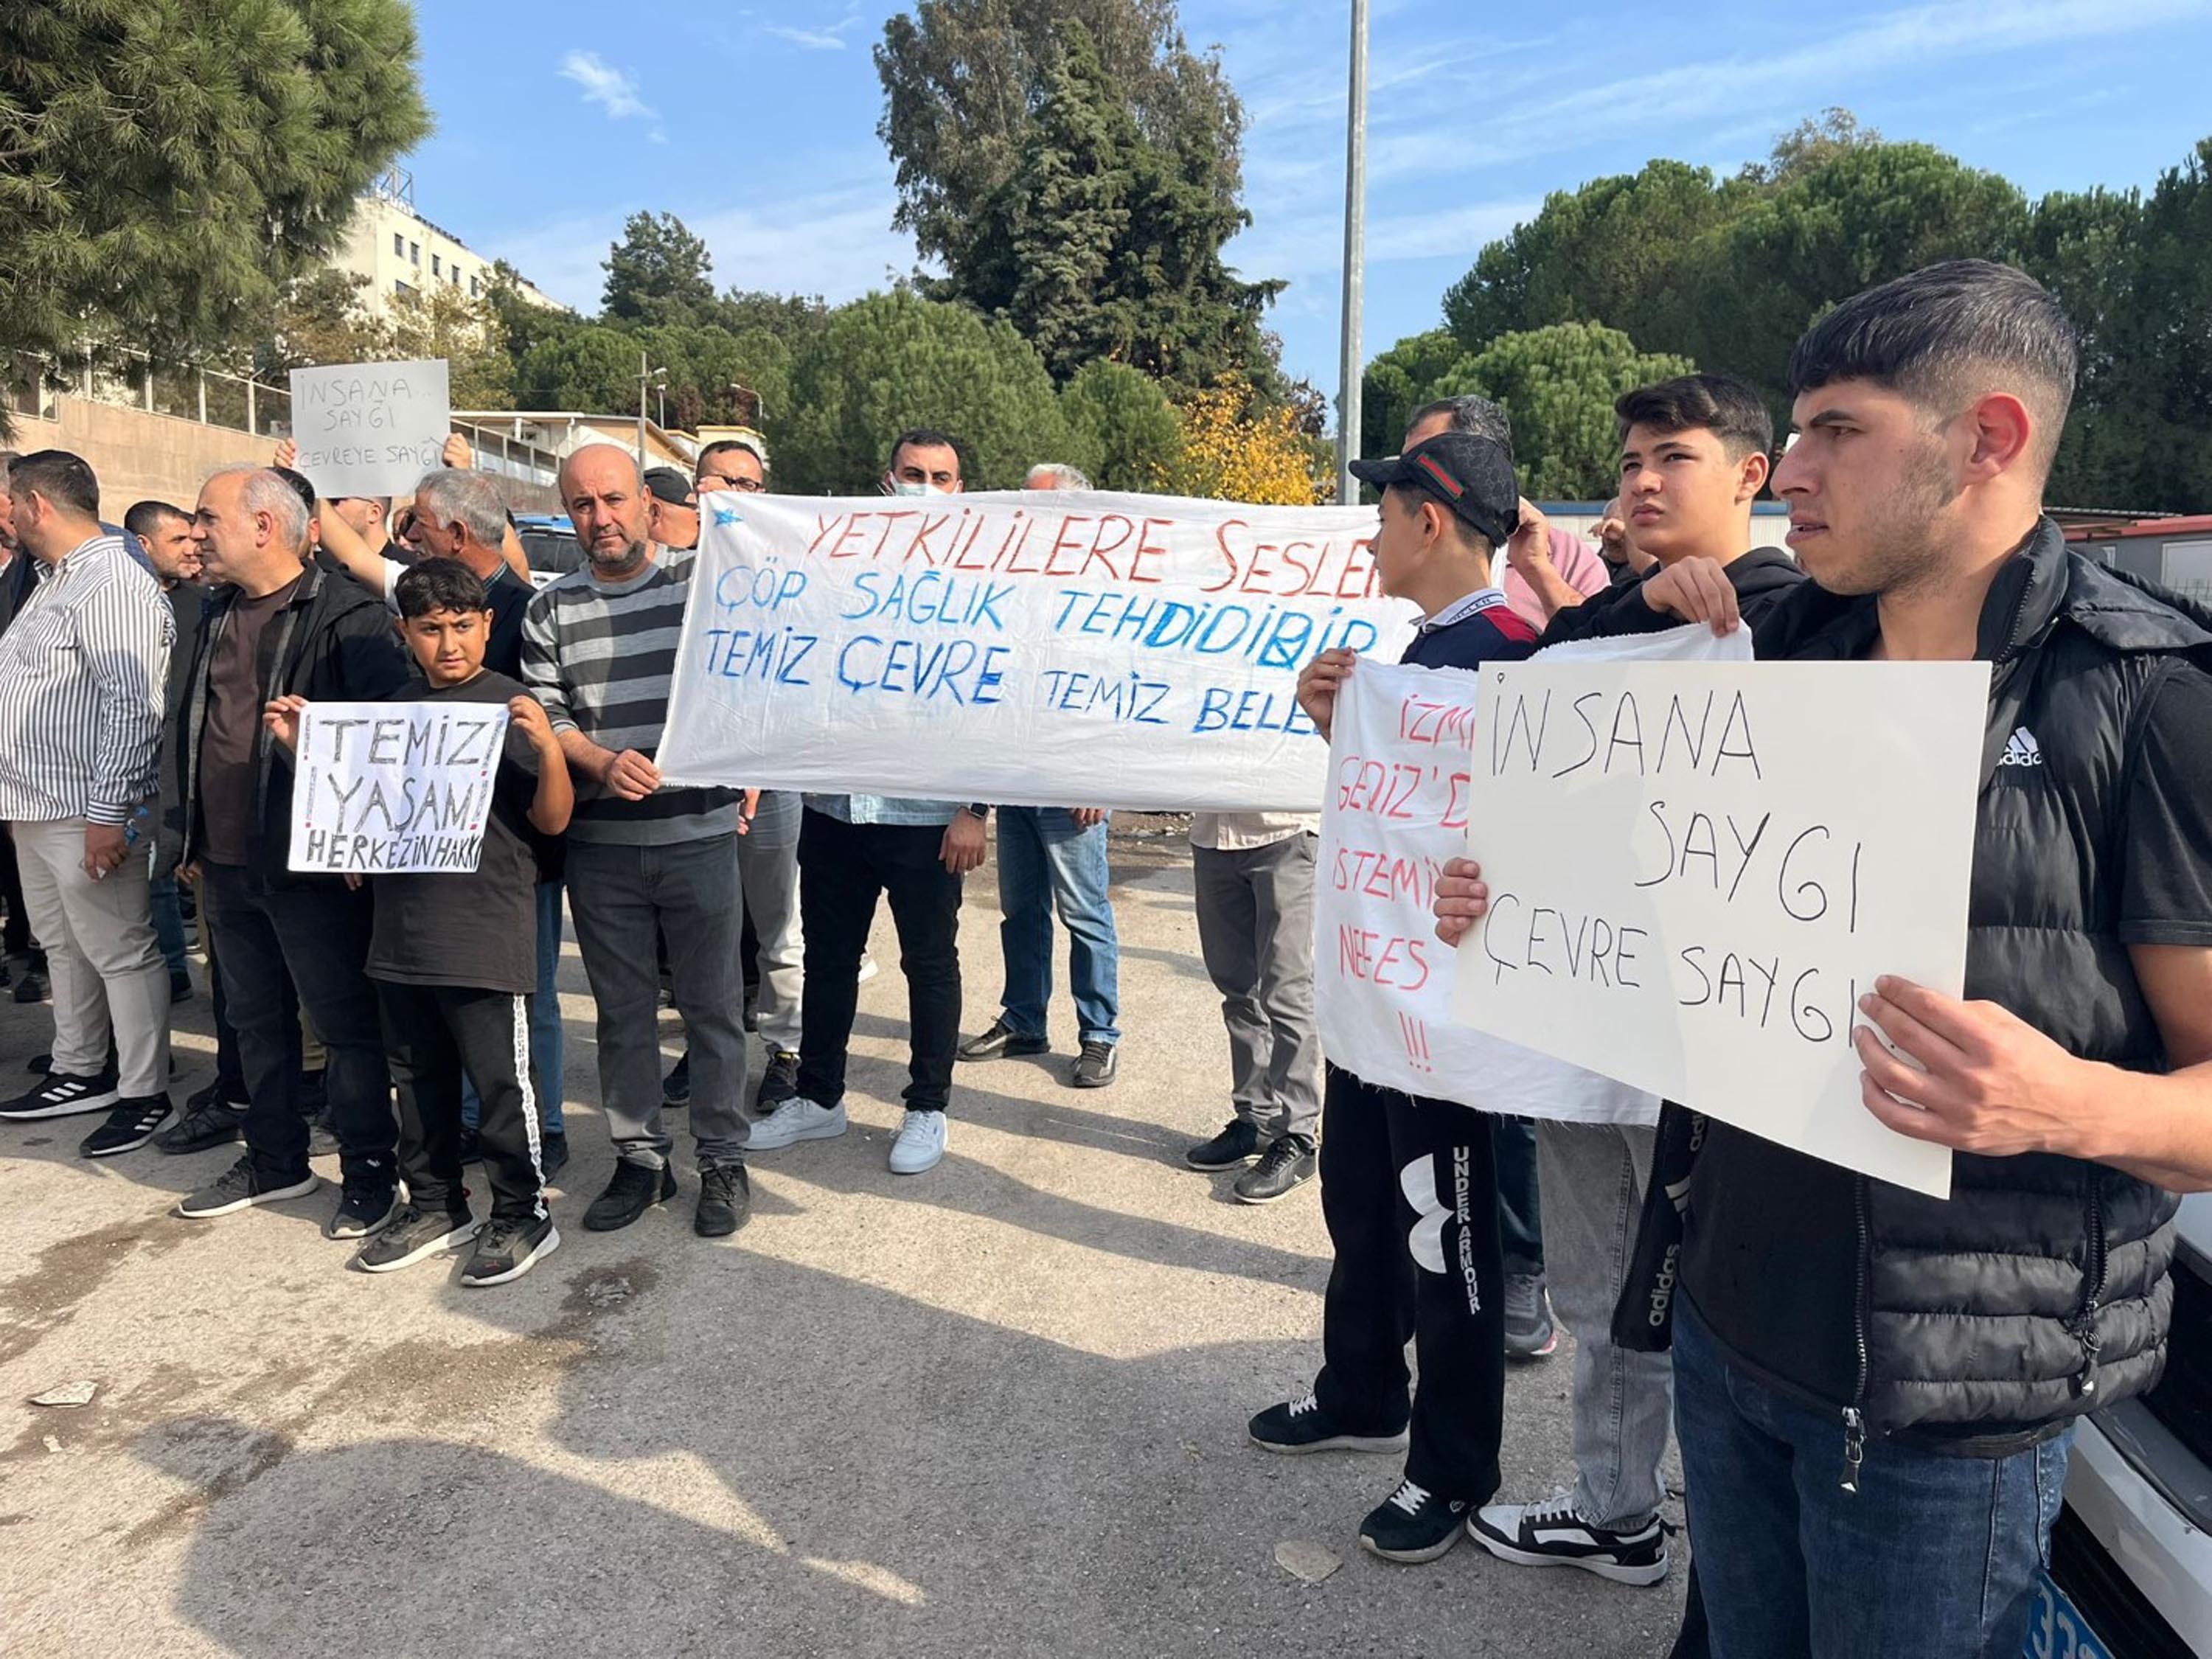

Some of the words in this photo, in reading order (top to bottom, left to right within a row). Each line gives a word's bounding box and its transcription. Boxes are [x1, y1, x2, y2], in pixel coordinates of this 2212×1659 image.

[808, 507, 1175, 583] YETKİLİLERE
[715, 556, 807, 613] ÇÖP
[841, 571, 1017, 631] SAĞLIK
[706, 626, 818, 686] TEMİZ
[838, 635, 1011, 706] ÇEVRE
[1043, 669, 1172, 725] TEMİZ
[1192, 687, 1321, 735] BELE
[1492, 672, 1761, 780] İNSANA
[1332, 838, 1442, 909] İSTEMİ
[1634, 801, 1861, 933] SAYGI
[1484, 893, 1648, 985] ÇEVRE
[1679, 947, 1856, 1048] SAYGI
[1453, 1145, 1471, 1225] UNDER
[1458, 1225, 1481, 1315] ARMOUR
[1649, 1243, 1681, 1326] adidas
